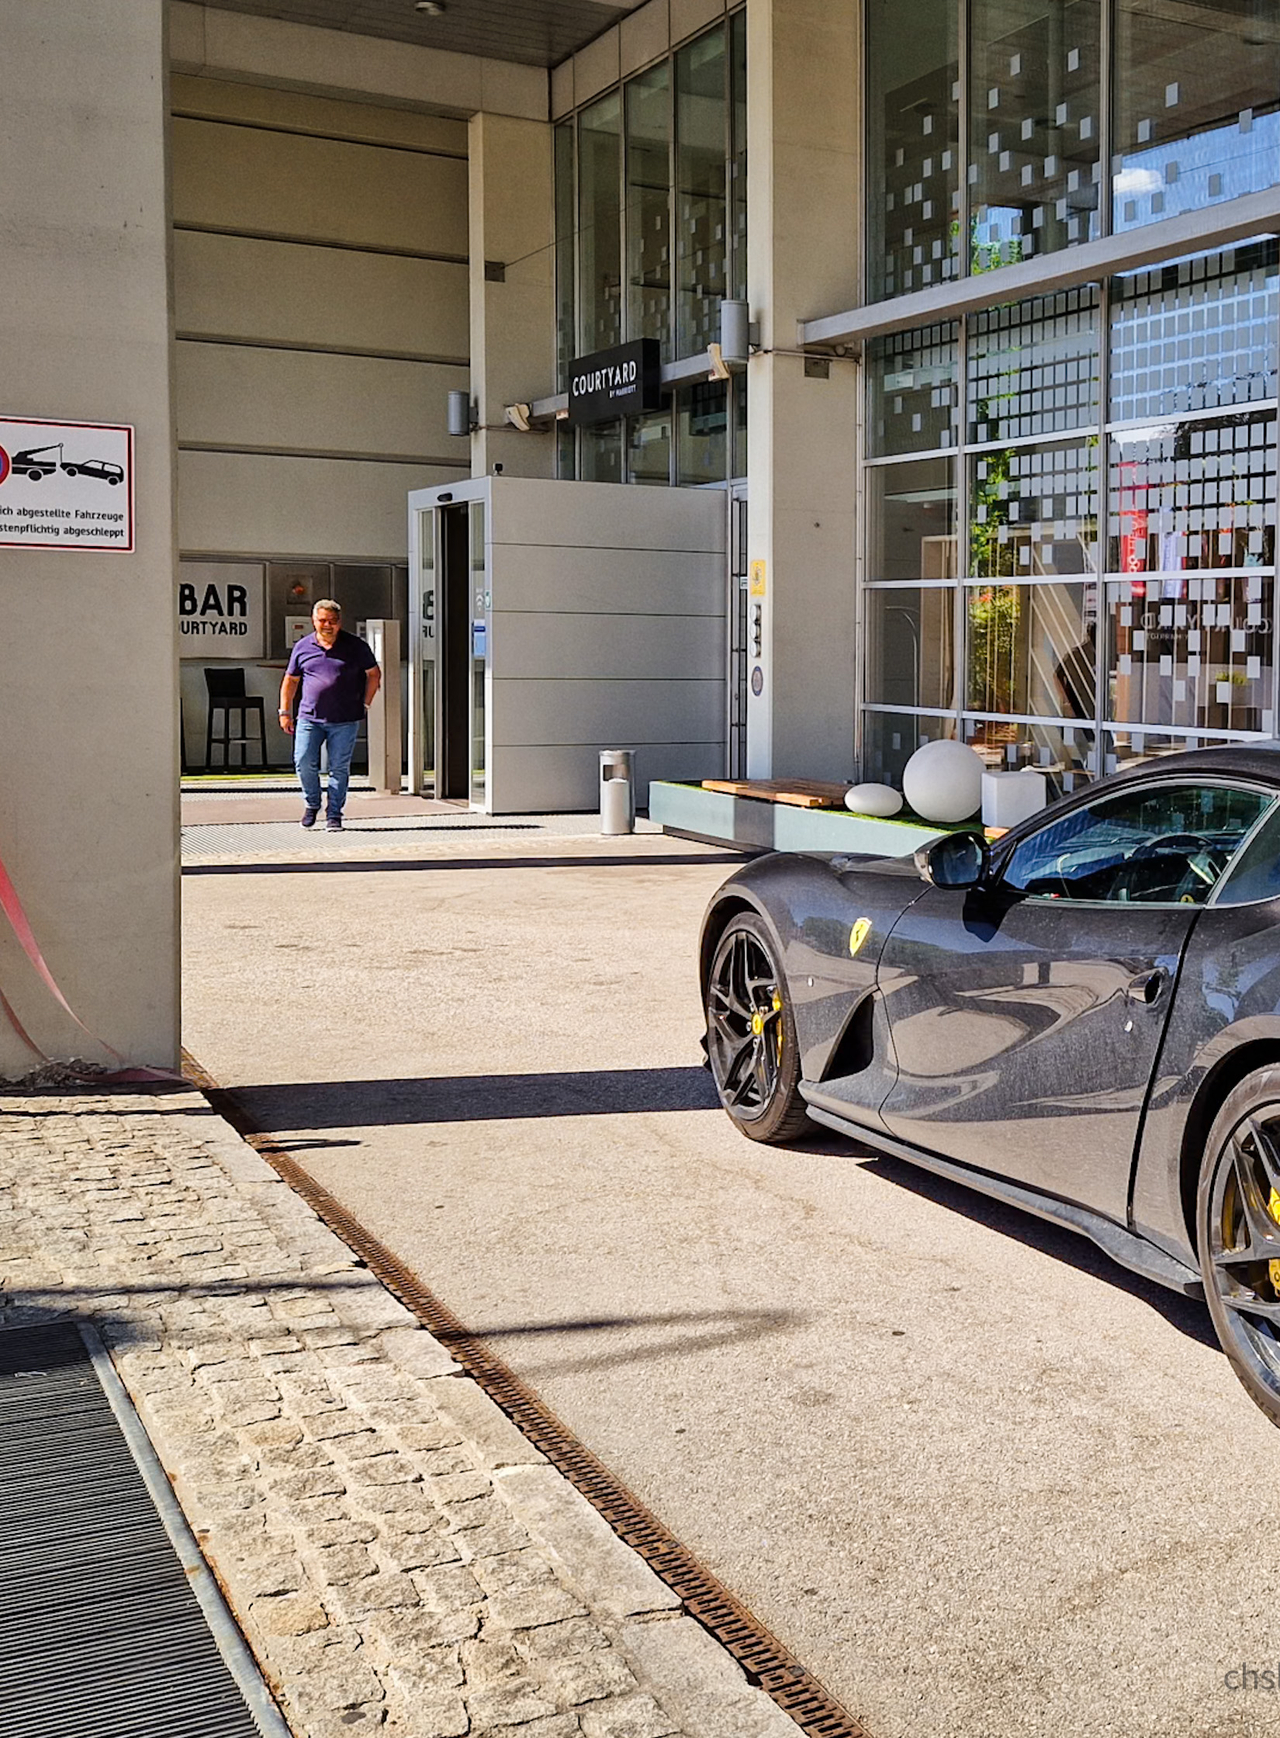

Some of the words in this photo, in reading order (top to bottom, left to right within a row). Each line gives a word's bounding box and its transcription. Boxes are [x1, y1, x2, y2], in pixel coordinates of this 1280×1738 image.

[572, 360, 637, 397] COURTYARD
[16, 507, 71, 519] abgestellte
[75, 510, 124, 522] Fahrzeuge
[63, 525, 124, 539] abgeschleppt
[179, 583, 247, 617] BAR
